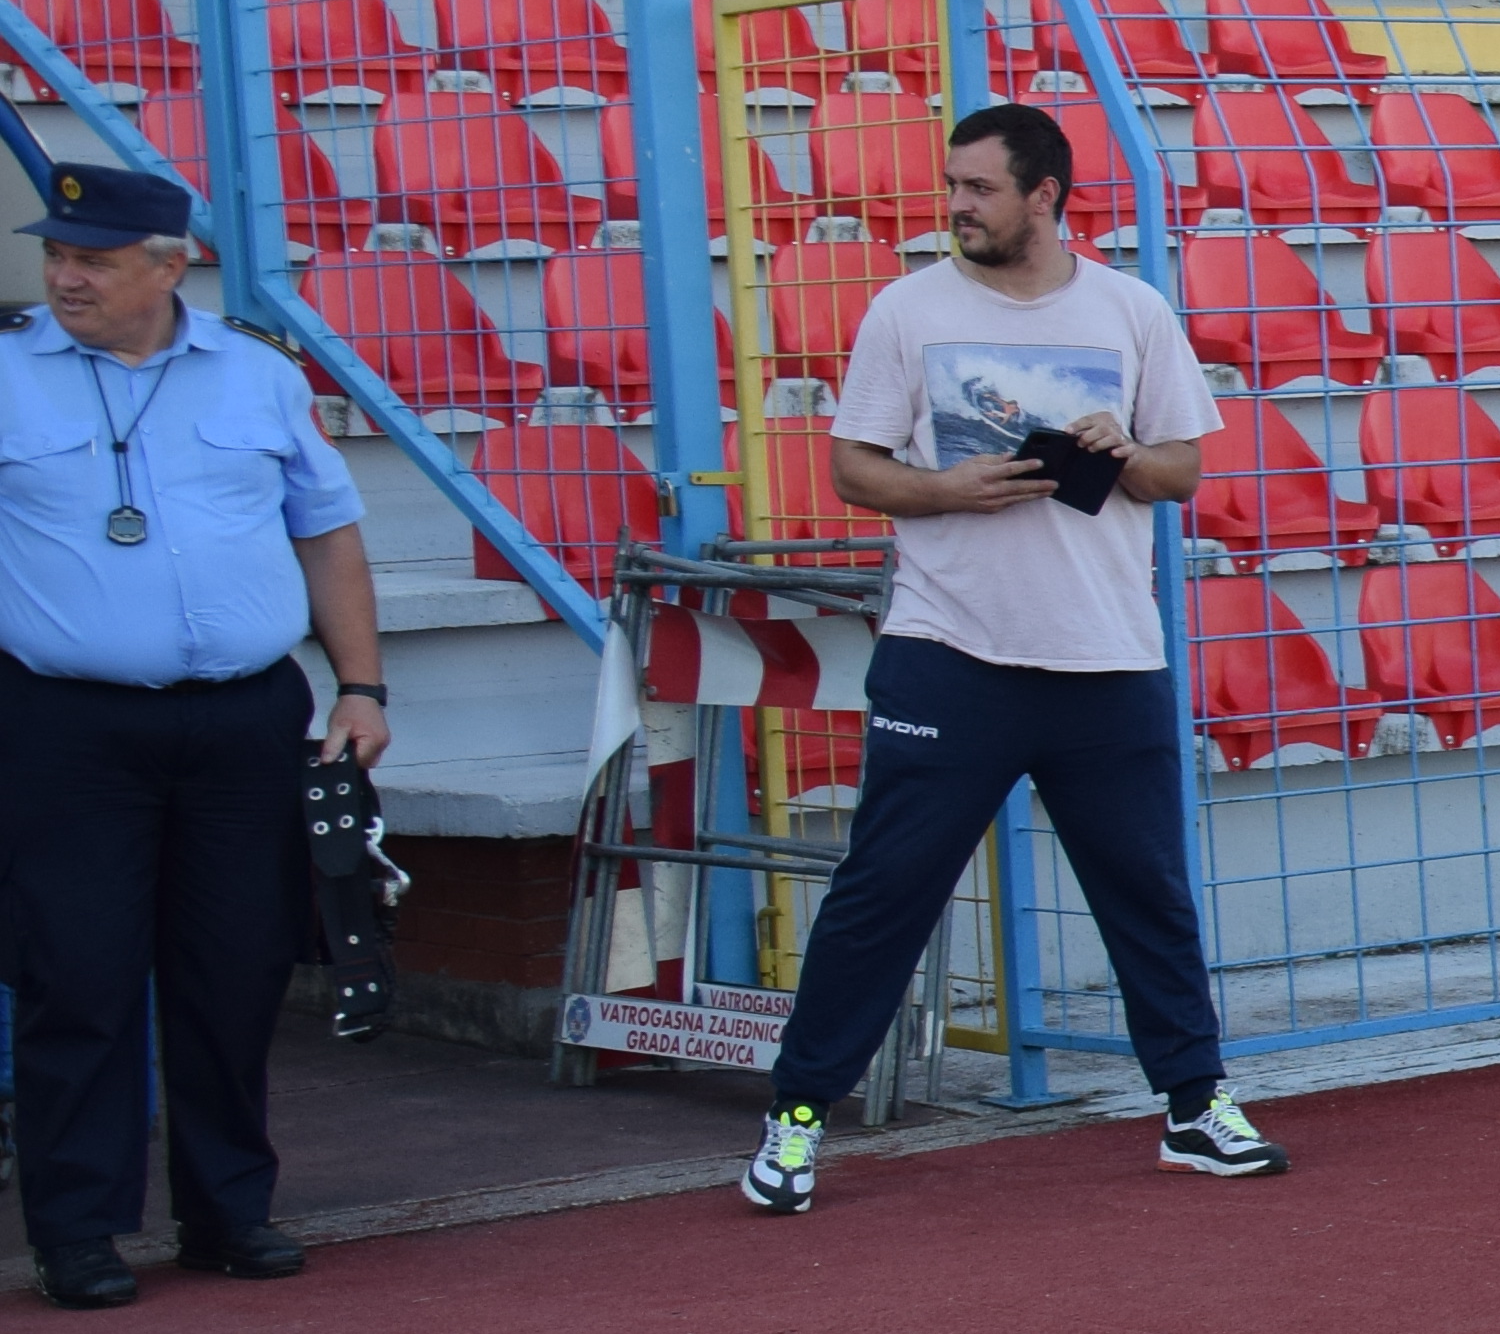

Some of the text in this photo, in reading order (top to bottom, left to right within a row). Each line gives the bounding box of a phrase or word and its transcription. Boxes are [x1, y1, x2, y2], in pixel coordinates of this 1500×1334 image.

[873, 716, 939, 739] GIVOVA
[710, 989, 793, 1015] VATROGASN
[600, 1002, 704, 1033] VATROGASNA
[627, 1030, 755, 1065] GRADA ČAKOVCA
